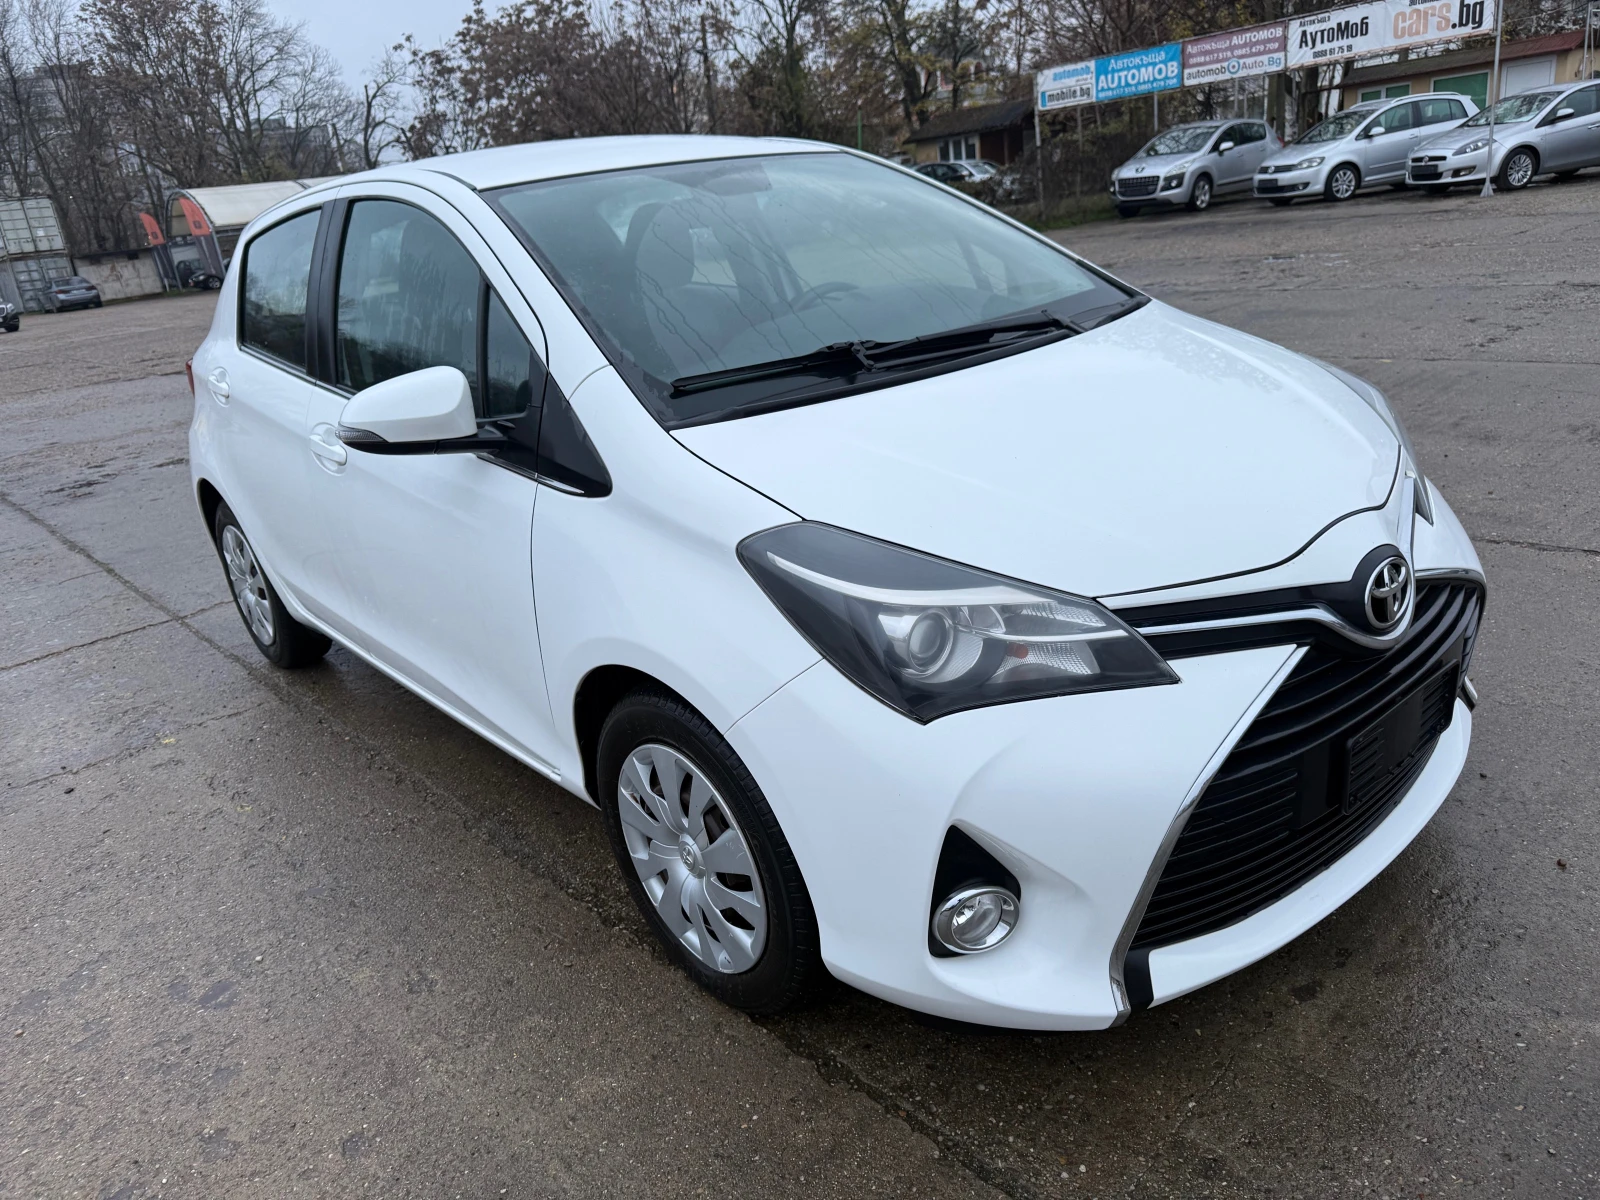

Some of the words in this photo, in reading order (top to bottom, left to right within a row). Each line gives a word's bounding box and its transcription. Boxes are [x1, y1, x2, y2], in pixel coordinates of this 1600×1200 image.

[1299, 16, 1369, 50] АутоМоб
[1393, 0, 1485, 39] cars.bg
[1186, 40, 1230, 54] Автокъща
[1231, 27, 1283, 46] AUTOMOB
[1108, 51, 1166, 71] Автокъща
[1186, 65, 1227, 80] automob
[1098, 61, 1178, 91] AUTOMOB
[1047, 86, 1091, 103] mobile.bg
